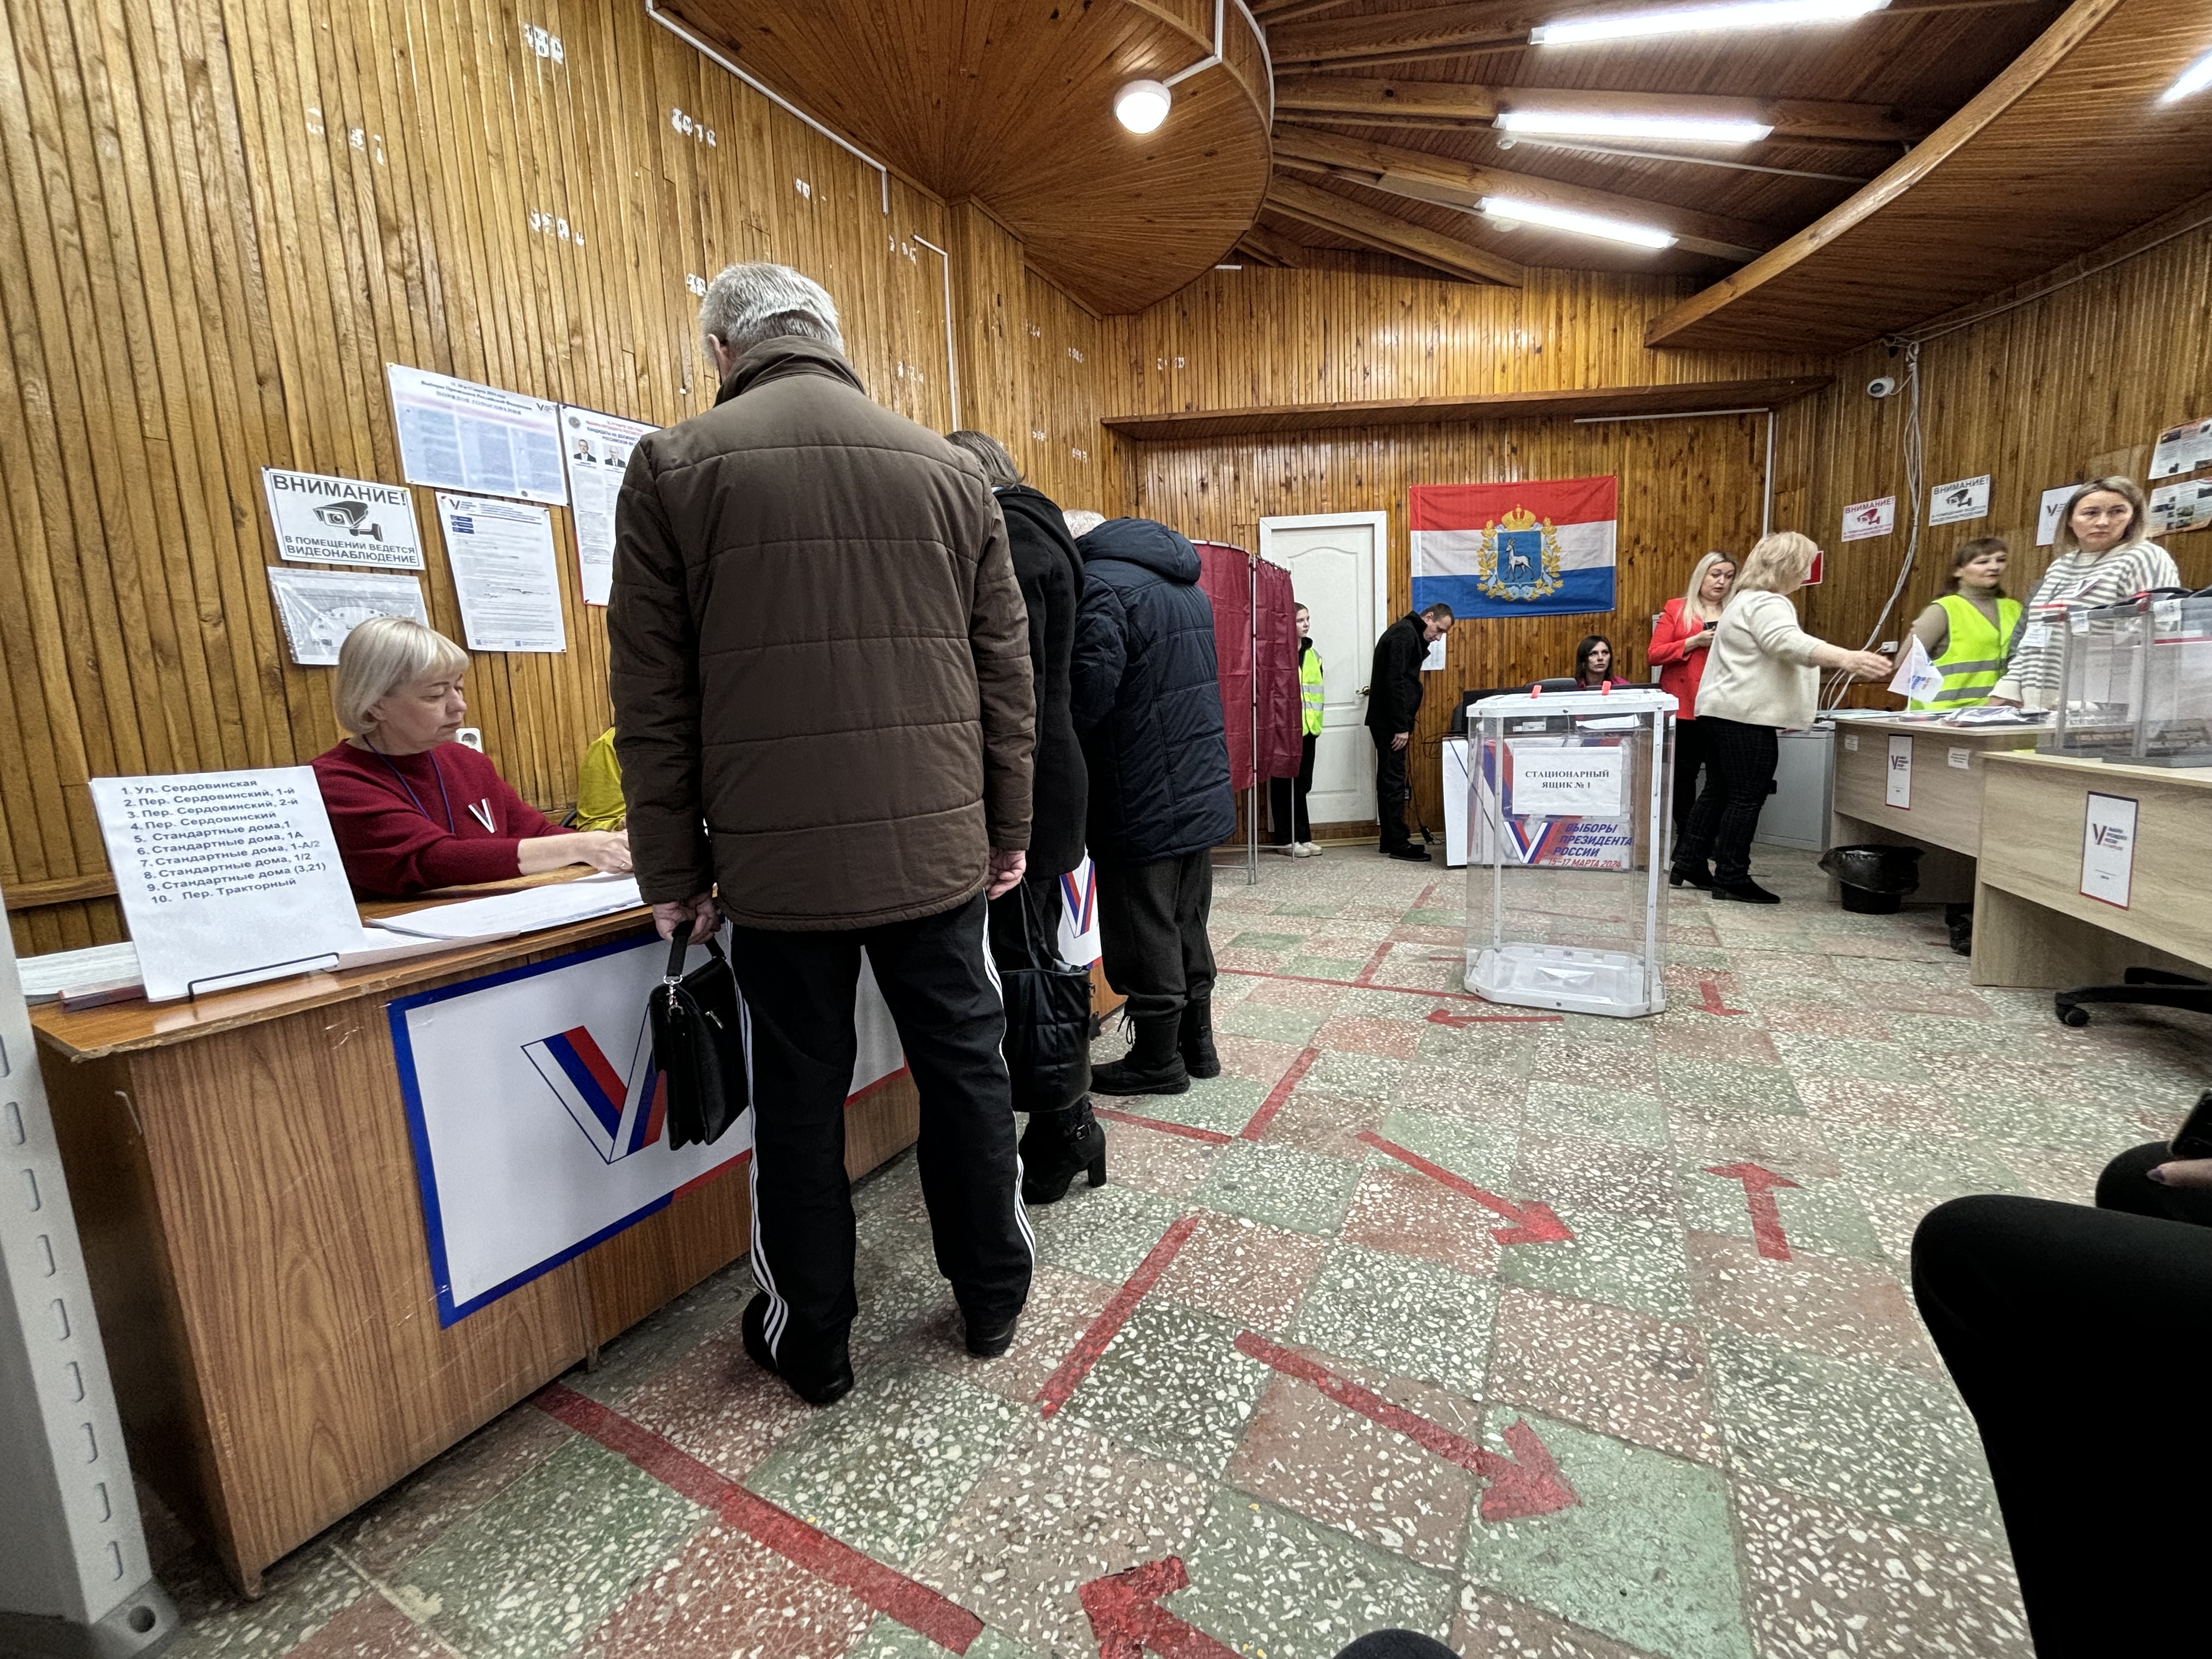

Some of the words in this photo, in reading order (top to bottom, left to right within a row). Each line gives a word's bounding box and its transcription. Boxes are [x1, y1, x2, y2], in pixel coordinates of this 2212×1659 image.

[273, 475, 407, 506] ВНИМАНИЕ!
[1934, 477, 1989, 494] ВНИМАНИЕ!
[1845, 498, 1894, 514] ВНИМАНИЕ!
[296, 537, 366, 550] ПОМЕЩЕНИИ
[370, 544, 415, 554] ВЕДЕТСЯ
[287, 545, 417, 564] ВИДЕОНАБЛЮДЕНИЕ
[1525, 770, 1610, 778] СТАЦИОНАРНЫЙ
[161, 781, 257, 793] Сердовинская
[174, 790, 274, 803] Сердовинский,
[177, 800, 277, 815] Сердовинский,
[180, 810, 276, 826] Сердовинский
[153, 827, 245, 840] Стандартные
[1565, 823, 1618, 833] ВЫБОРЫ
[152, 839, 244, 853] Стандартные
[249, 834, 284, 844] дома,
[1559, 836, 1633, 846] ПРЕЗИДЕНТА
[155, 850, 248, 865] Стандартные
[251, 845, 288, 855] дома,
[1553, 847, 1600, 857] РОССИИ
[159, 862, 251, 877] Стандартные
[255, 857, 292, 867] дома,
[1571, 859, 1599, 867] МАРТА
[1600, 860, 1622, 868] 2024
[162, 873, 255, 889] Стандартные
[258, 868, 291, 878] дома
[294, 862, 326, 874] (3,21)
[151, 895, 172, 904] 10.
[216, 878, 296, 895] Тракторный
